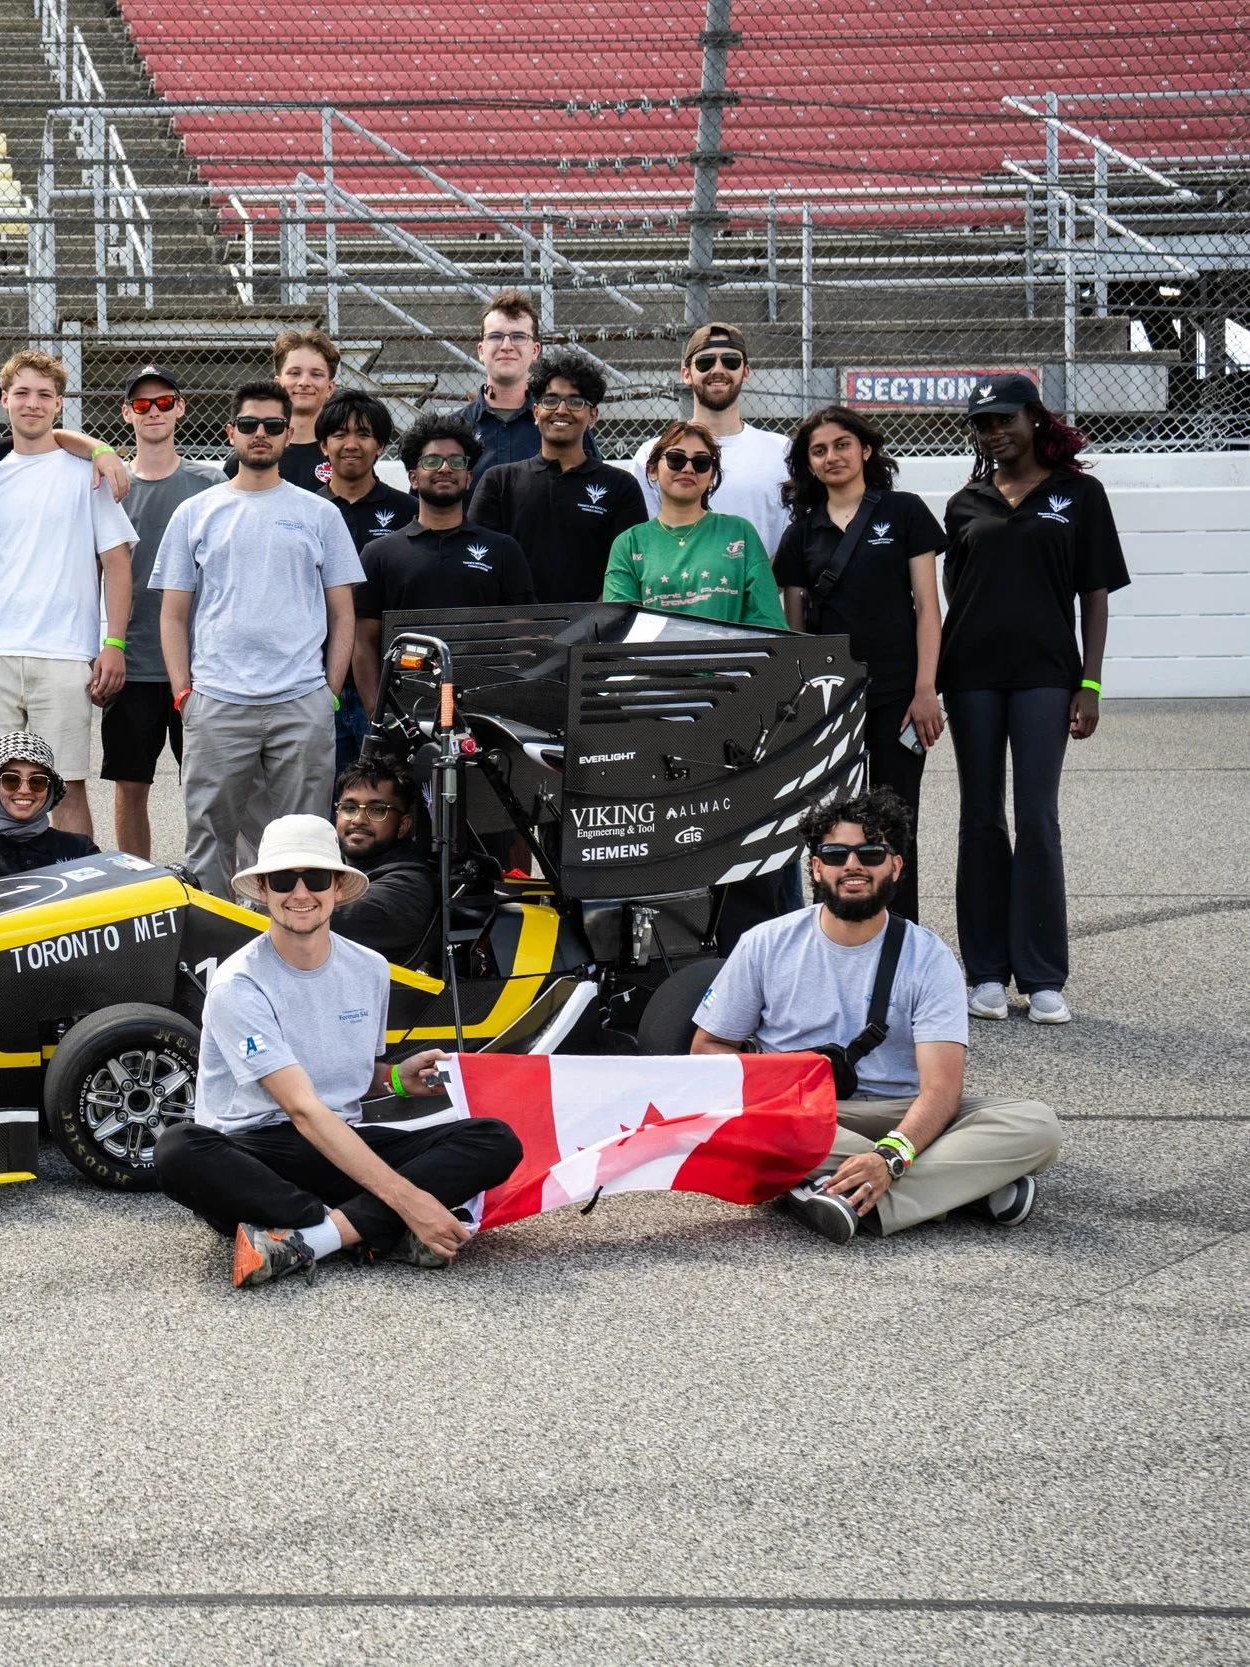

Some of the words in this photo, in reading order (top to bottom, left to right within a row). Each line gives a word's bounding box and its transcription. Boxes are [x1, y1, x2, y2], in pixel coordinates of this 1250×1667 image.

[855, 377, 977, 401] SECTION
[579, 752, 636, 764] EVERLIGHT
[570, 803, 655, 828] VIKING
[679, 798, 731, 817] ALMAC
[577, 828, 625, 839] Engineering
[627, 825, 635, 834] &
[637, 823, 655, 833] Tool
[683, 832, 702, 843] EIS
[582, 843, 649, 861] SIEMENS
[10, 925, 120, 973] TORONTO
[134, 908, 178, 943] MET
[338, 1012, 359, 1020] Formula
[239, 1034, 267, 1059] SAE
[164, 1048, 197, 1078] KEIZER
[79, 1074, 92, 1122] FORGED
